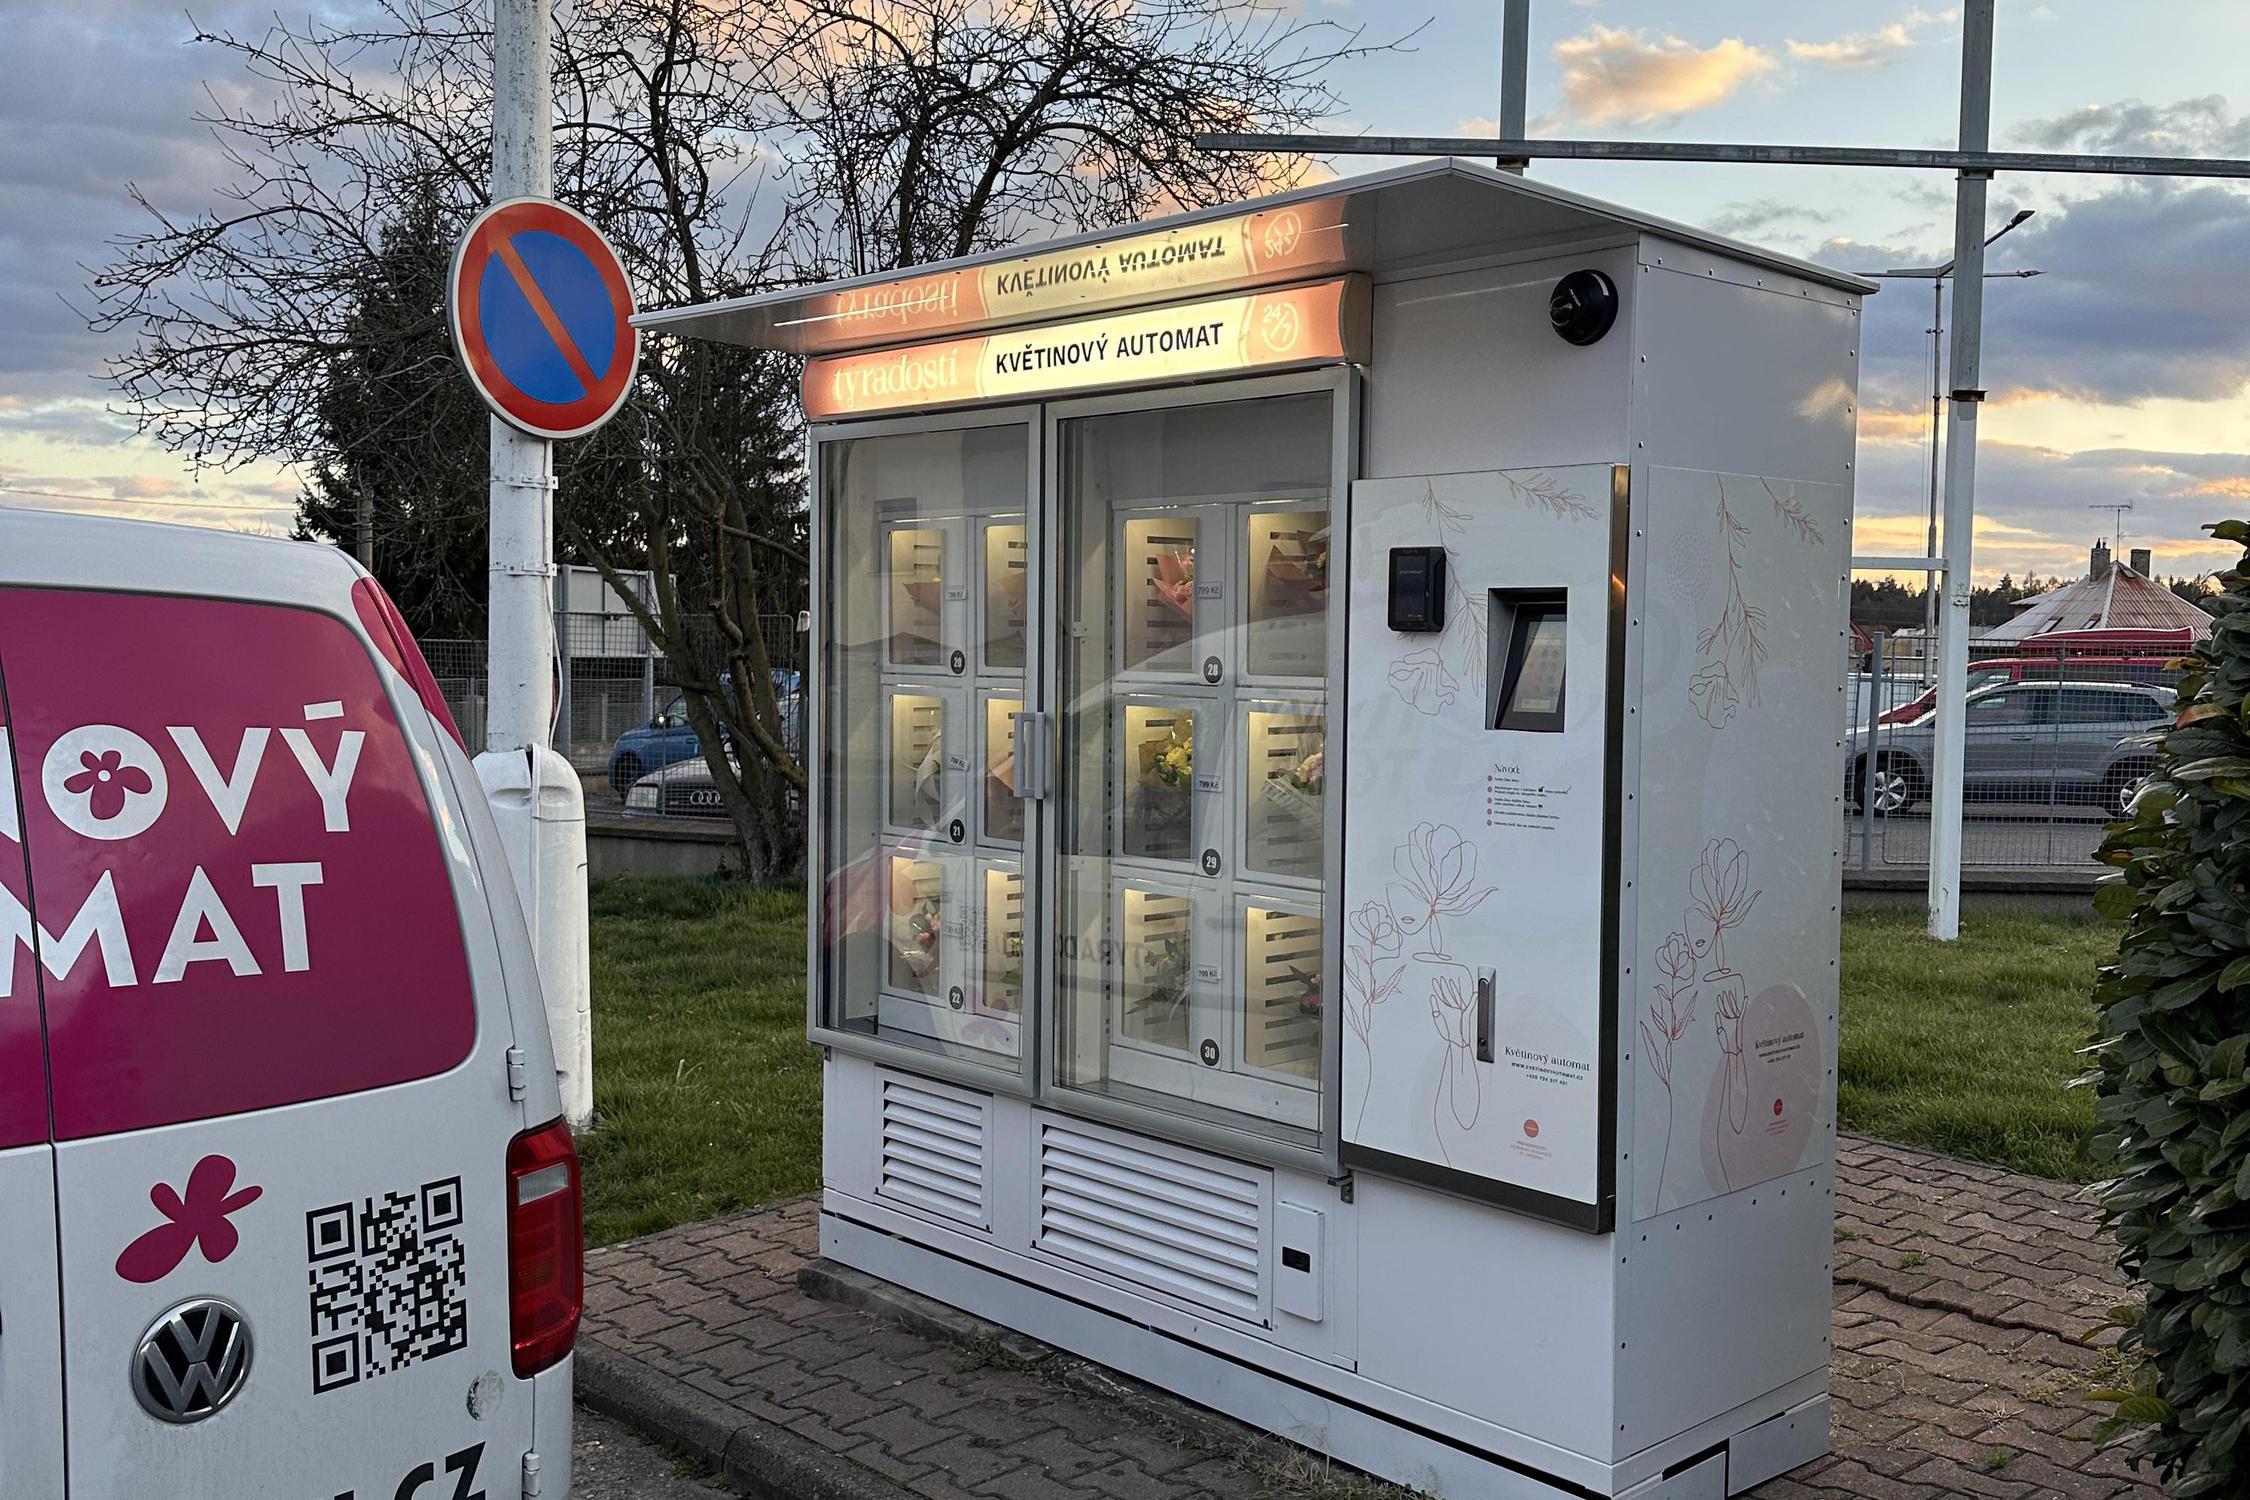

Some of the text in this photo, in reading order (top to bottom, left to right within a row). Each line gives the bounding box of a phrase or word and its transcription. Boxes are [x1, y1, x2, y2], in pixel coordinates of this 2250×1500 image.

[996, 322, 1224, 374] KVĚTINOVÝ AUTOMAT
[834, 348, 959, 408] tyradosti
[1207, 663, 1219, 676] 28
[0, 700, 366, 842] OVÝ
[952, 825, 961, 836] 21
[1206, 855, 1217, 869] 29
[951, 992, 961, 1004] 22
[1204, 1046, 1216, 1060] 30
[1505, 1046, 1590, 1071] Květinový automat
